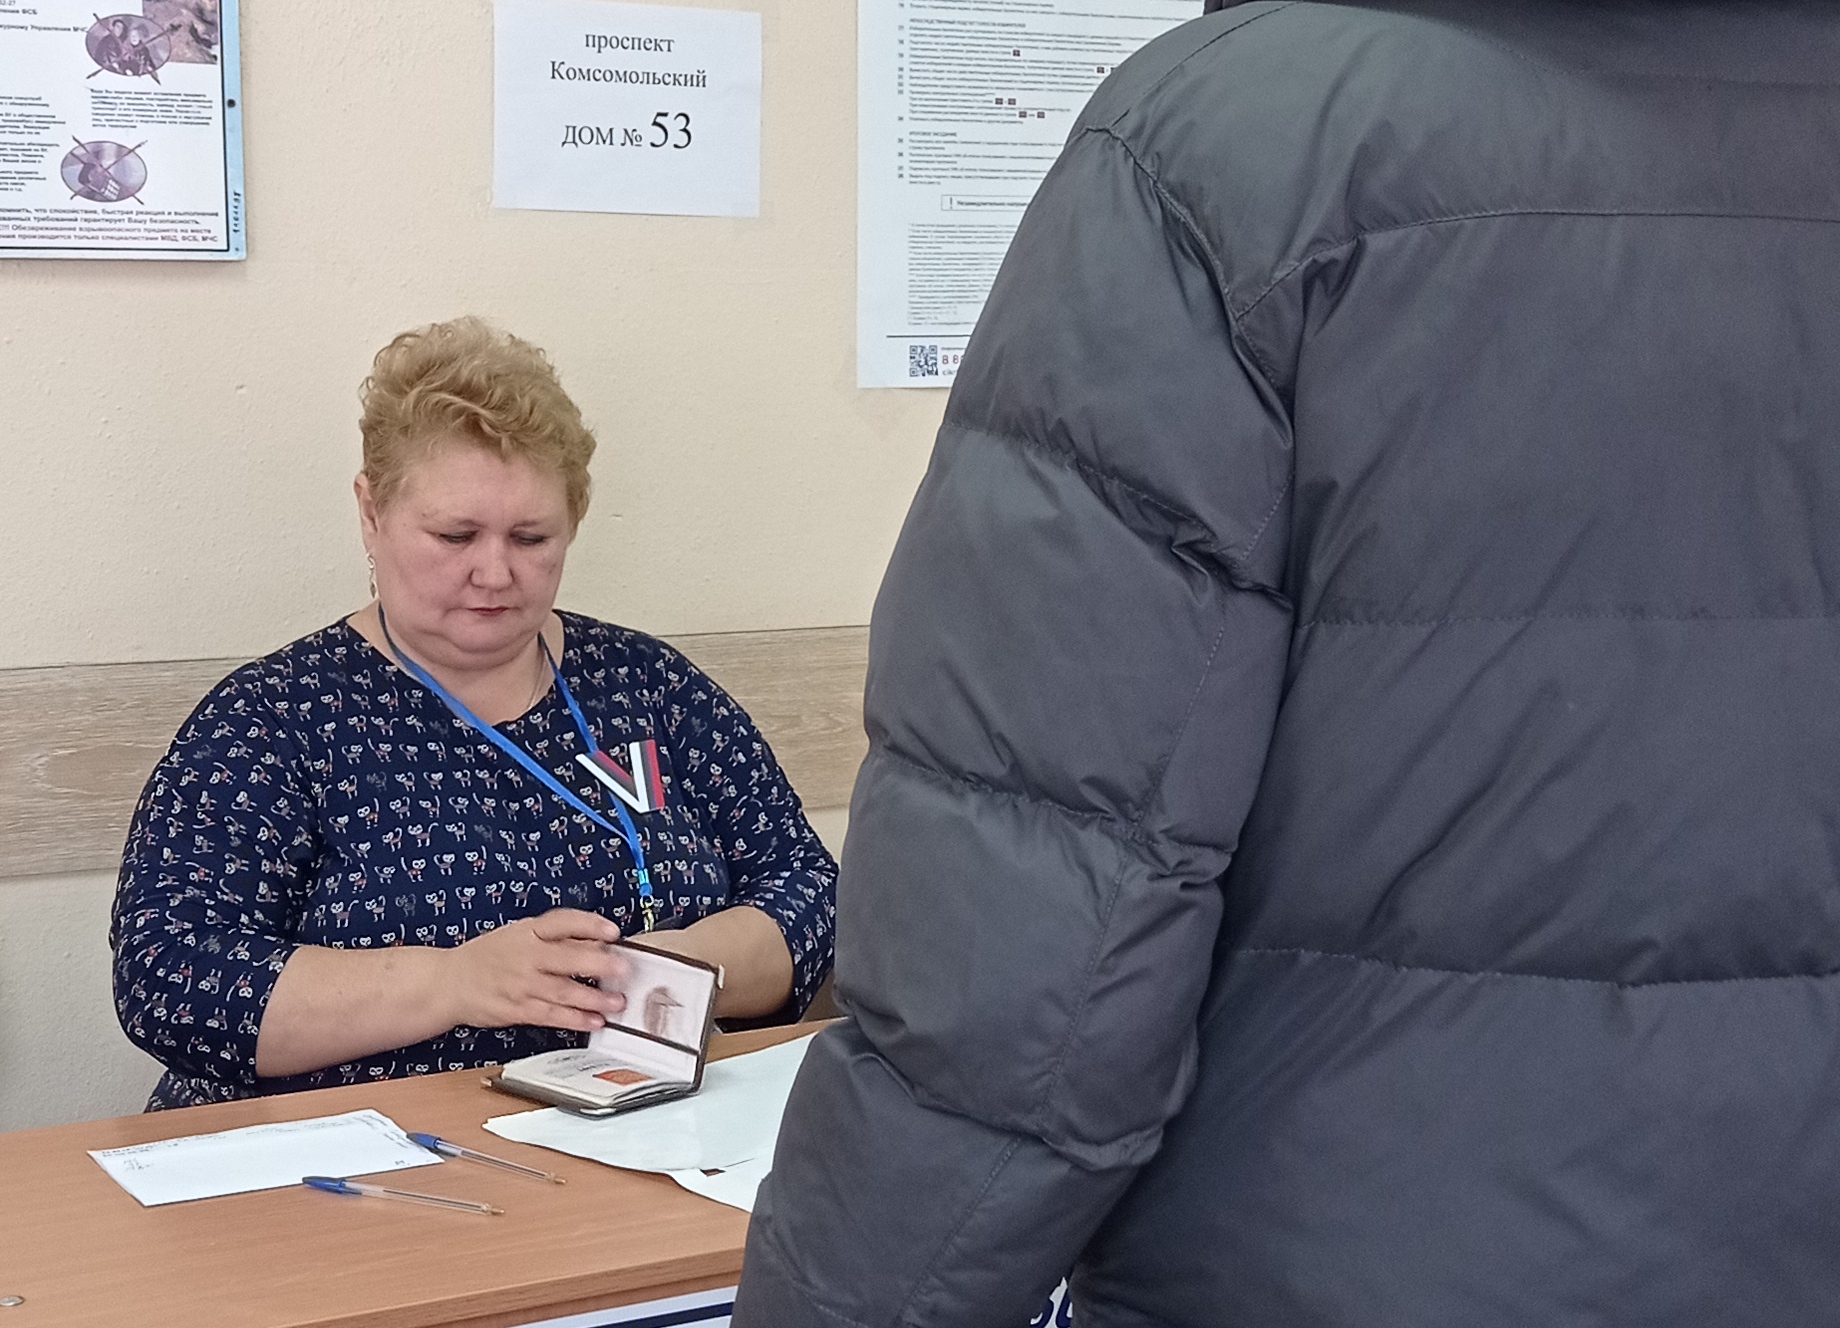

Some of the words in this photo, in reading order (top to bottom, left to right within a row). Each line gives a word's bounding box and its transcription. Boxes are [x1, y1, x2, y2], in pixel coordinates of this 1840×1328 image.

[584, 33, 675, 54] проспект
[550, 60, 708, 88] Комсомольский
[561, 125, 615, 149] ДОМ
[620, 128, 643, 147] №
[649, 111, 692, 150] 53
